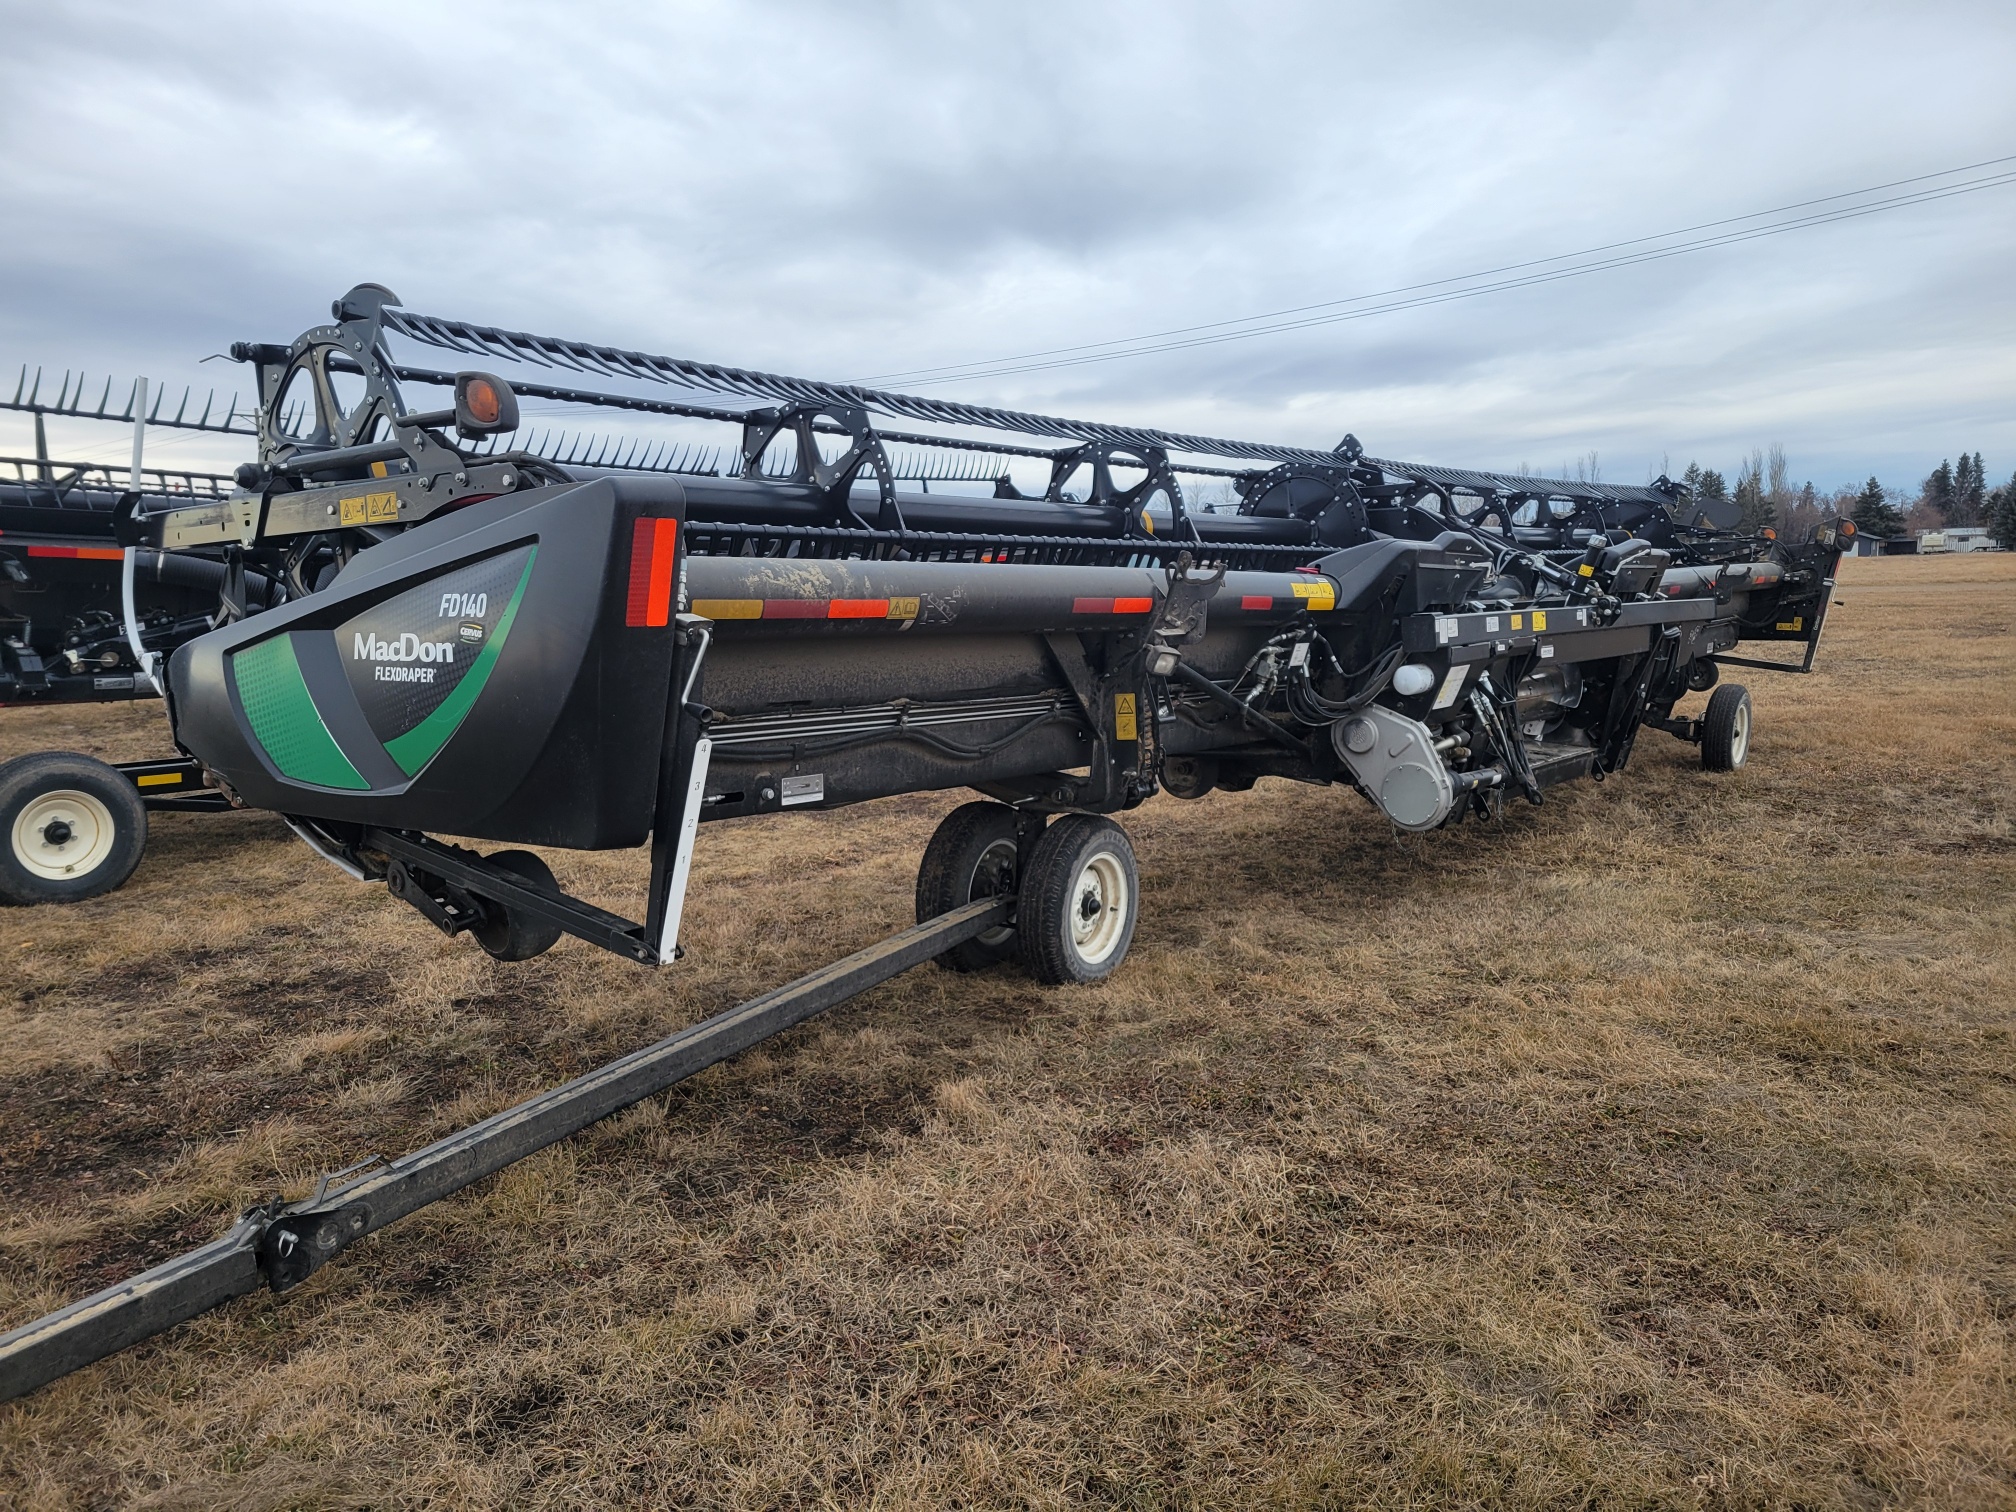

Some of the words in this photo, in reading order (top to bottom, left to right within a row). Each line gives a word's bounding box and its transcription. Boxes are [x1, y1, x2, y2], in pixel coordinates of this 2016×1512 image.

[439, 593, 487, 618] FD140
[460, 627, 483, 638] CERVUS
[353, 632, 454, 663] MacDon
[375, 666, 434, 683] FLEXDRAPER
[701, 743, 707, 753] 4
[694, 781, 701, 791] 3
[687, 818, 694, 828] 2
[682, 855, 686, 864] 1
